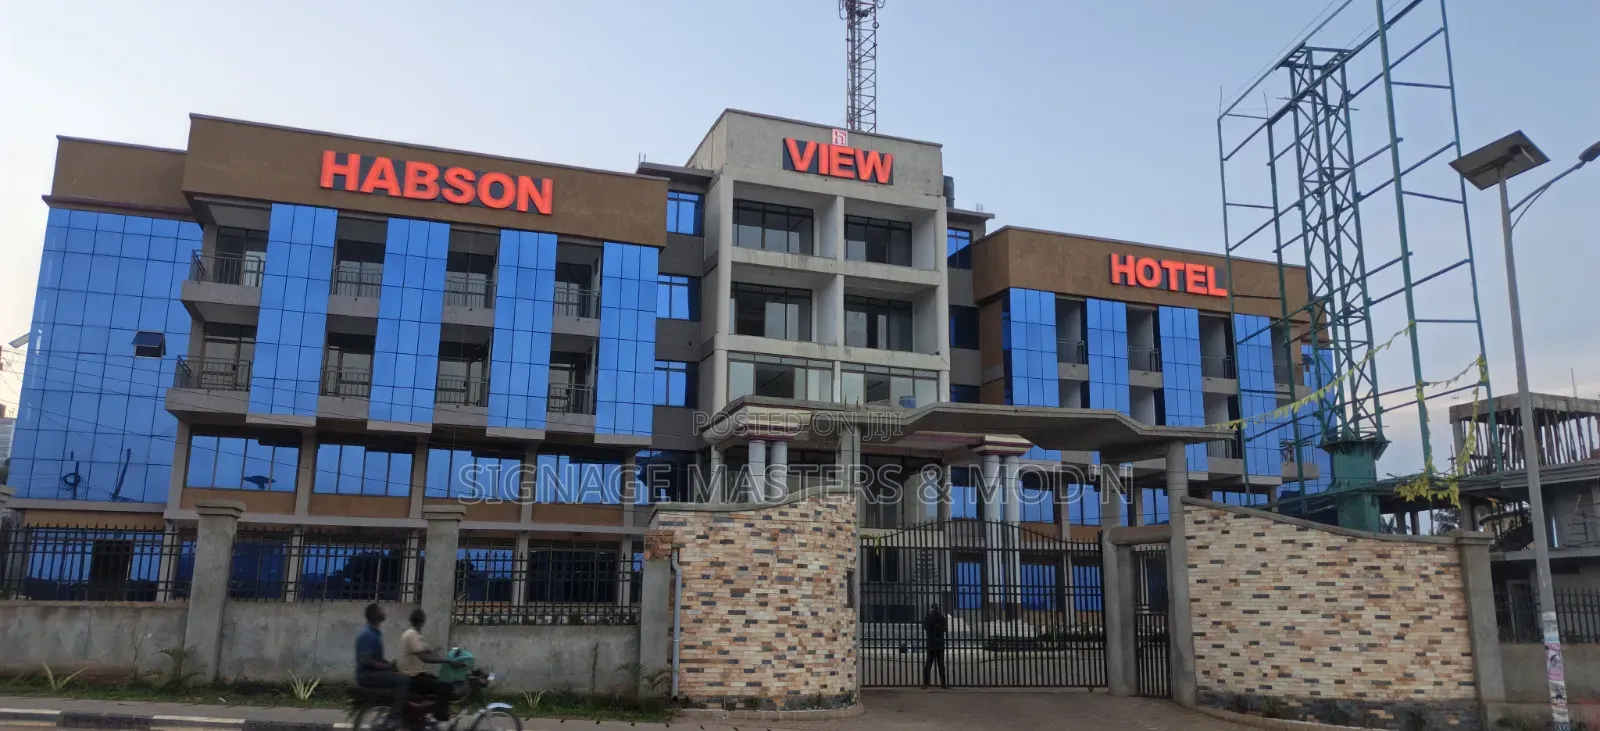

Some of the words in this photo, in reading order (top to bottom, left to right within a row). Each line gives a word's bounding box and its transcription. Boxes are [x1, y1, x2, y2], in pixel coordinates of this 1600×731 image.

[320, 150, 553, 215] HABSON
[784, 137, 893, 184] VIEW
[1110, 252, 1228, 297] HOTEL
